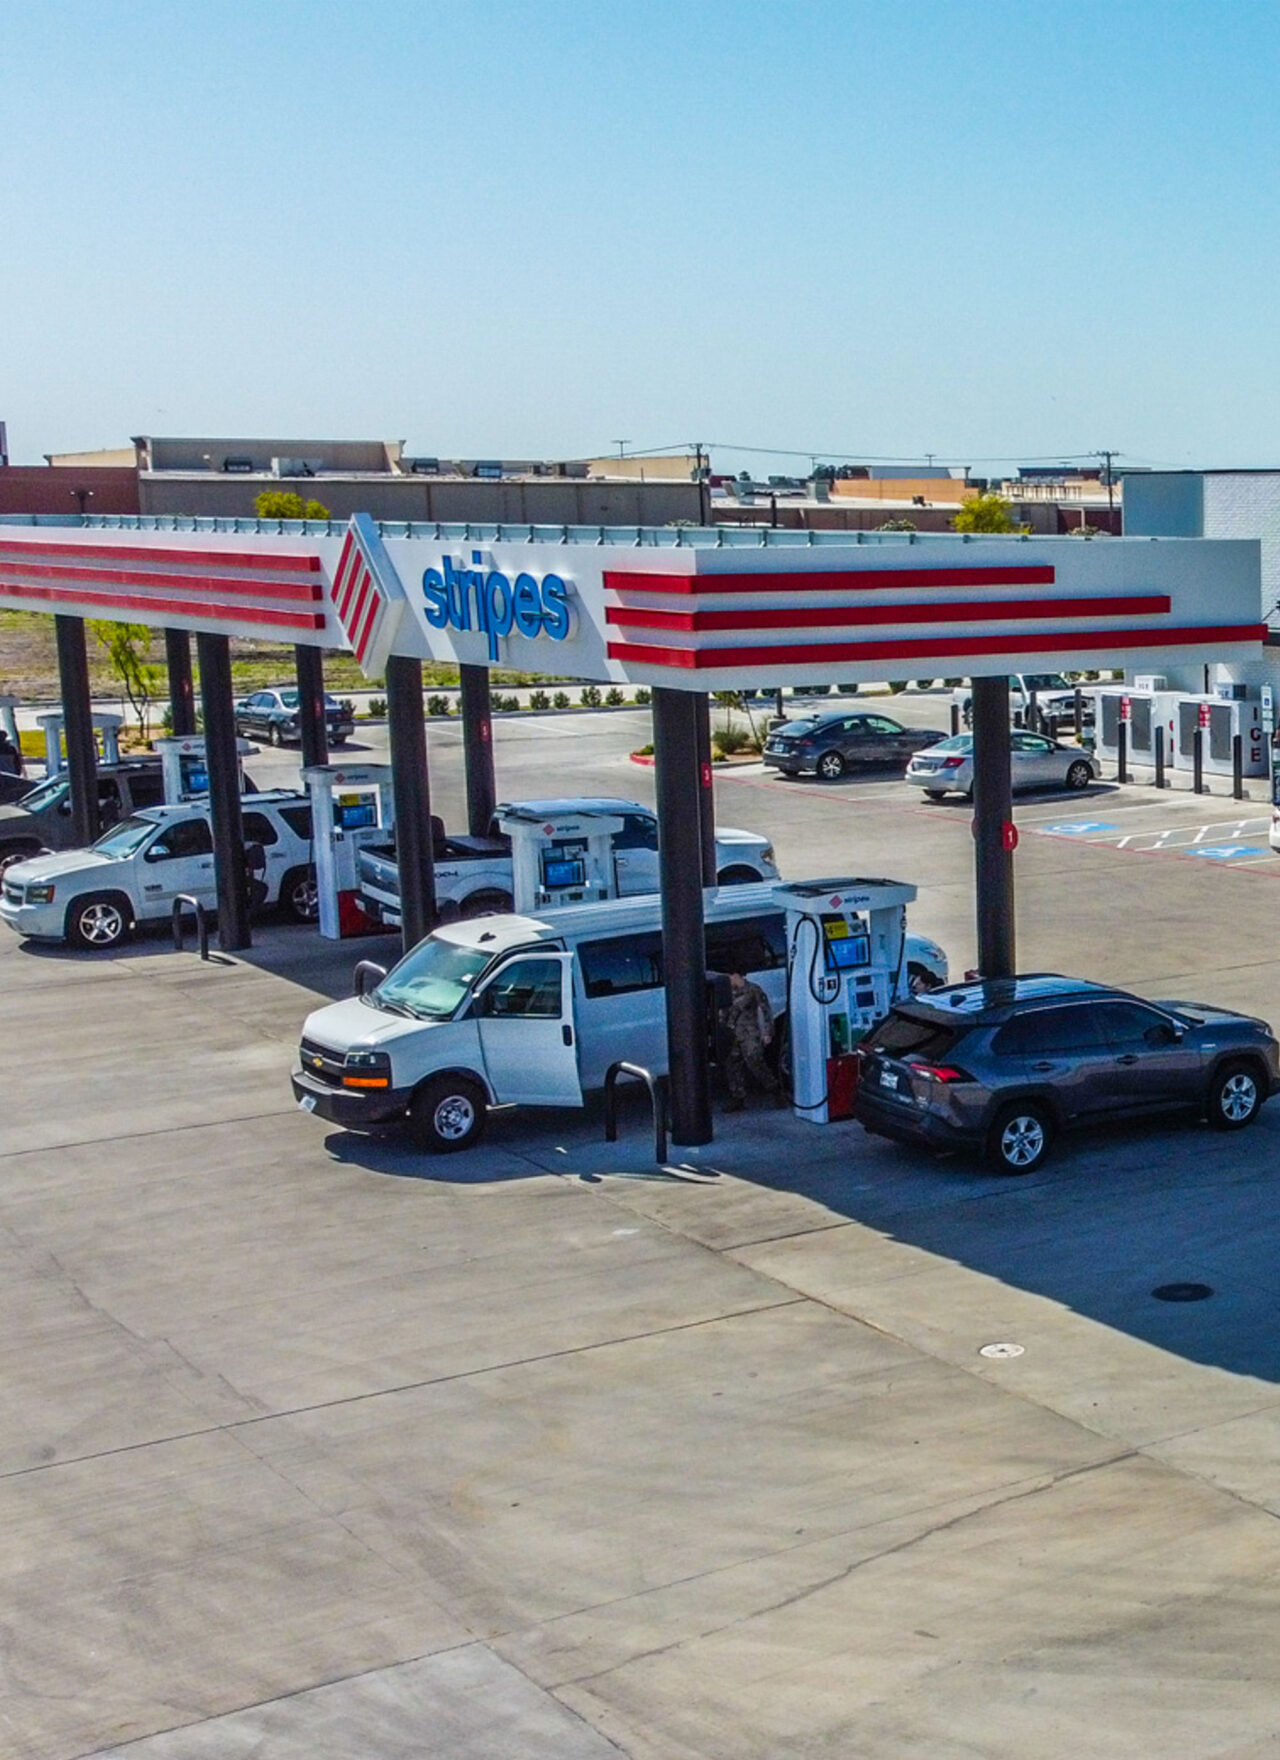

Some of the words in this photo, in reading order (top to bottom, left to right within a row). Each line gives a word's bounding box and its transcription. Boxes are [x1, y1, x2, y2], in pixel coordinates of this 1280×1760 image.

[423, 550, 570, 662] stripes
[1008, 830, 1013, 843] 1
[843, 895, 871, 905] stripes
